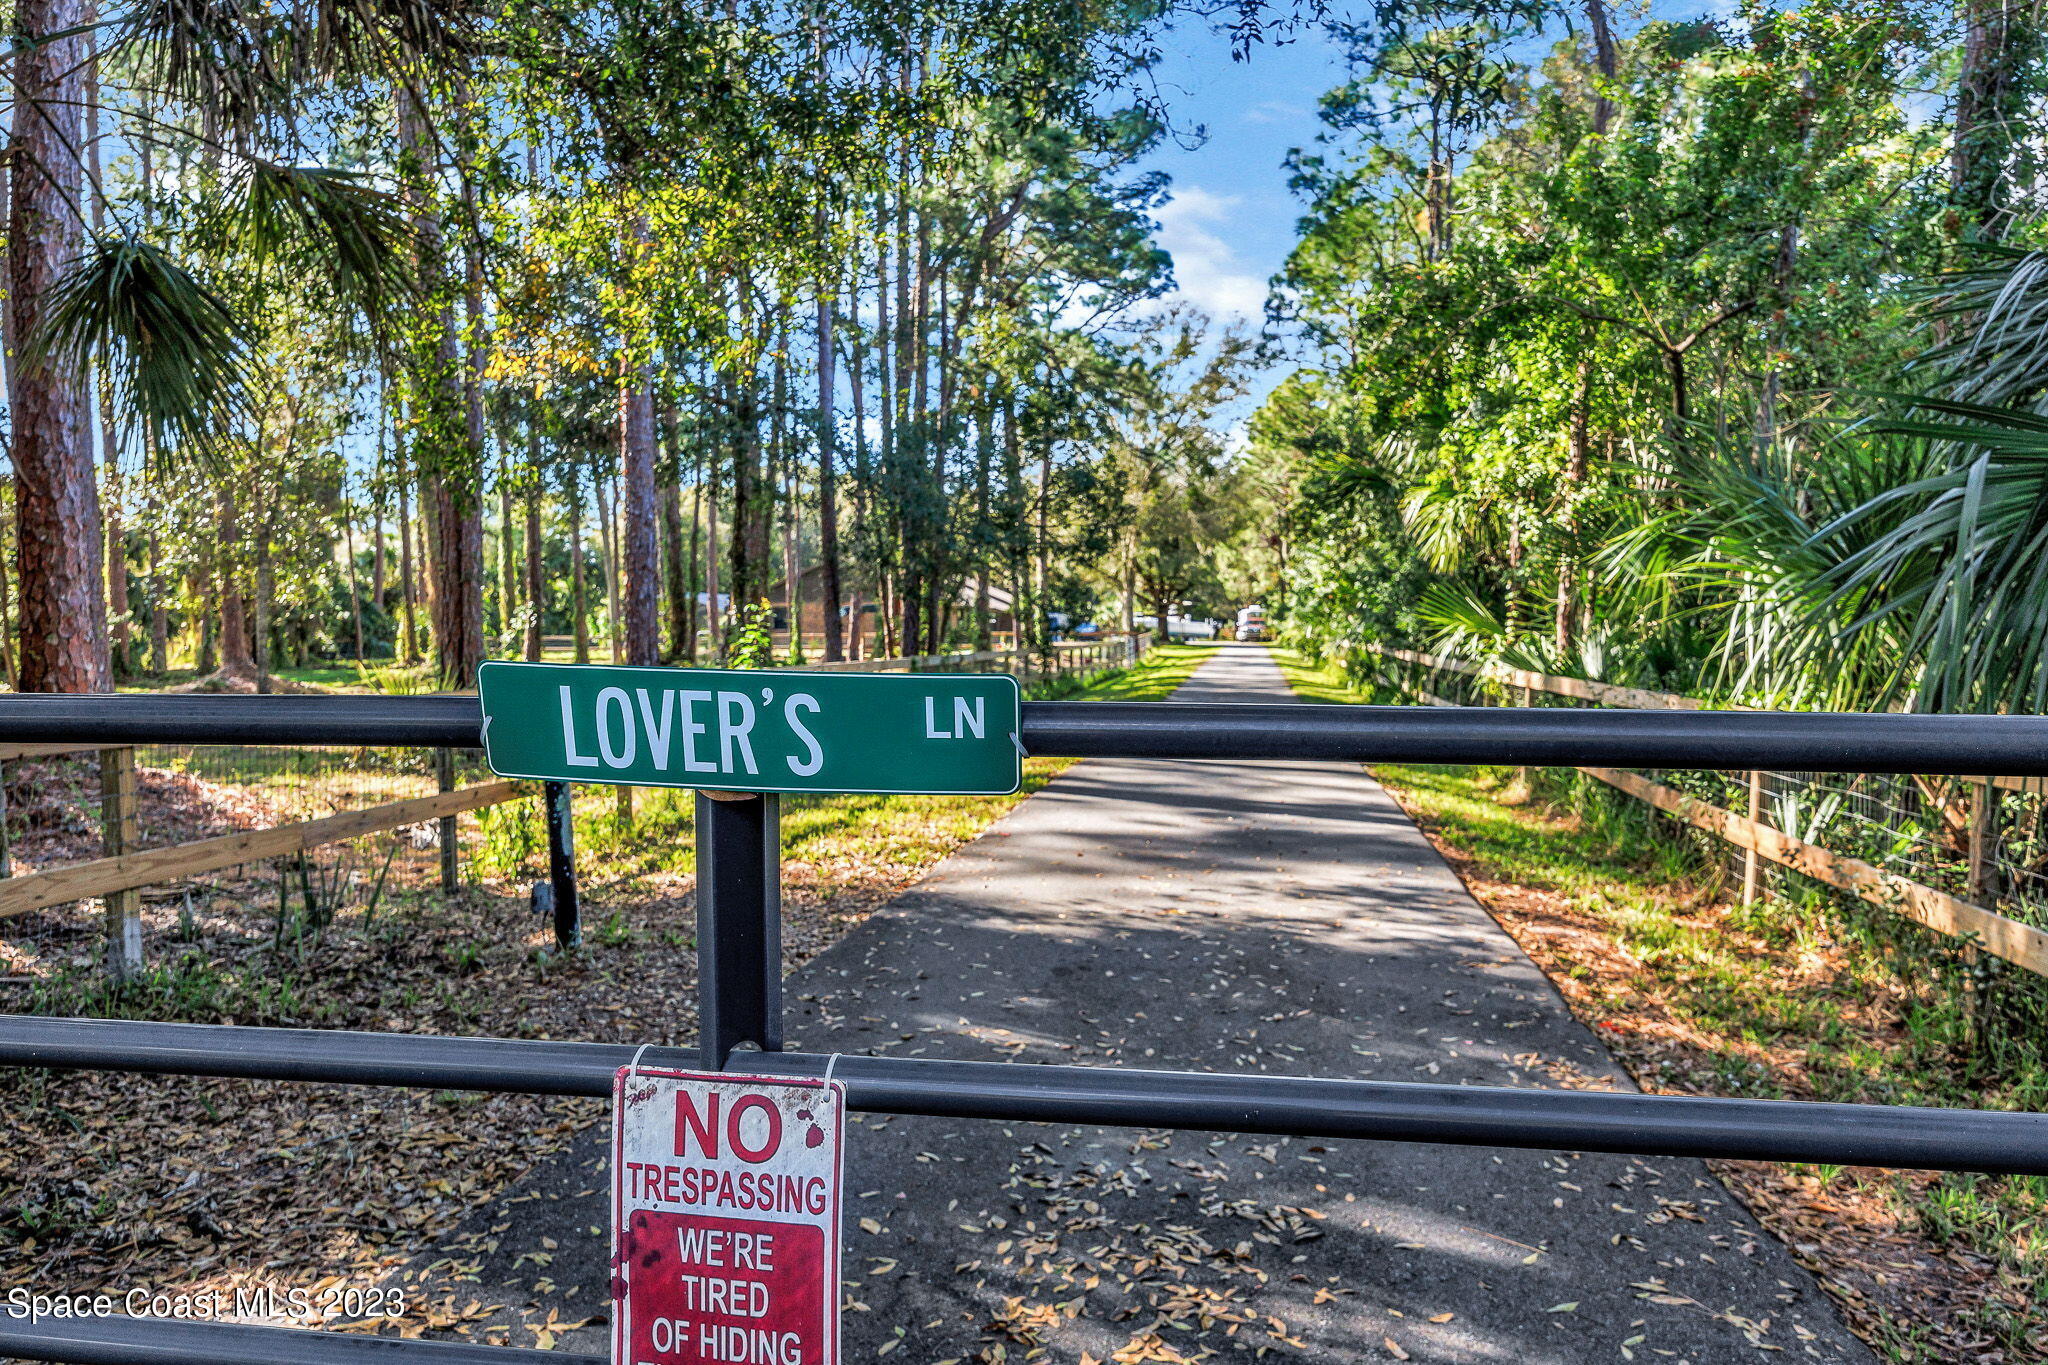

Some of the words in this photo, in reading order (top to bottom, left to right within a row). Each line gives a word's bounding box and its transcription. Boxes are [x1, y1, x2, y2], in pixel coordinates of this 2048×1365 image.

[559, 685, 825, 777] LOVER'S
[924, 696, 986, 740] LN
[673, 1089, 783, 1164] NO
[626, 1163, 826, 1215] TRESPASSING
[676, 1226, 774, 1272] WE'RE
[681, 1274, 770, 1319] TIRED
[651, 1317, 690, 1355] OF
[699, 1322, 802, 1365] HIDING
